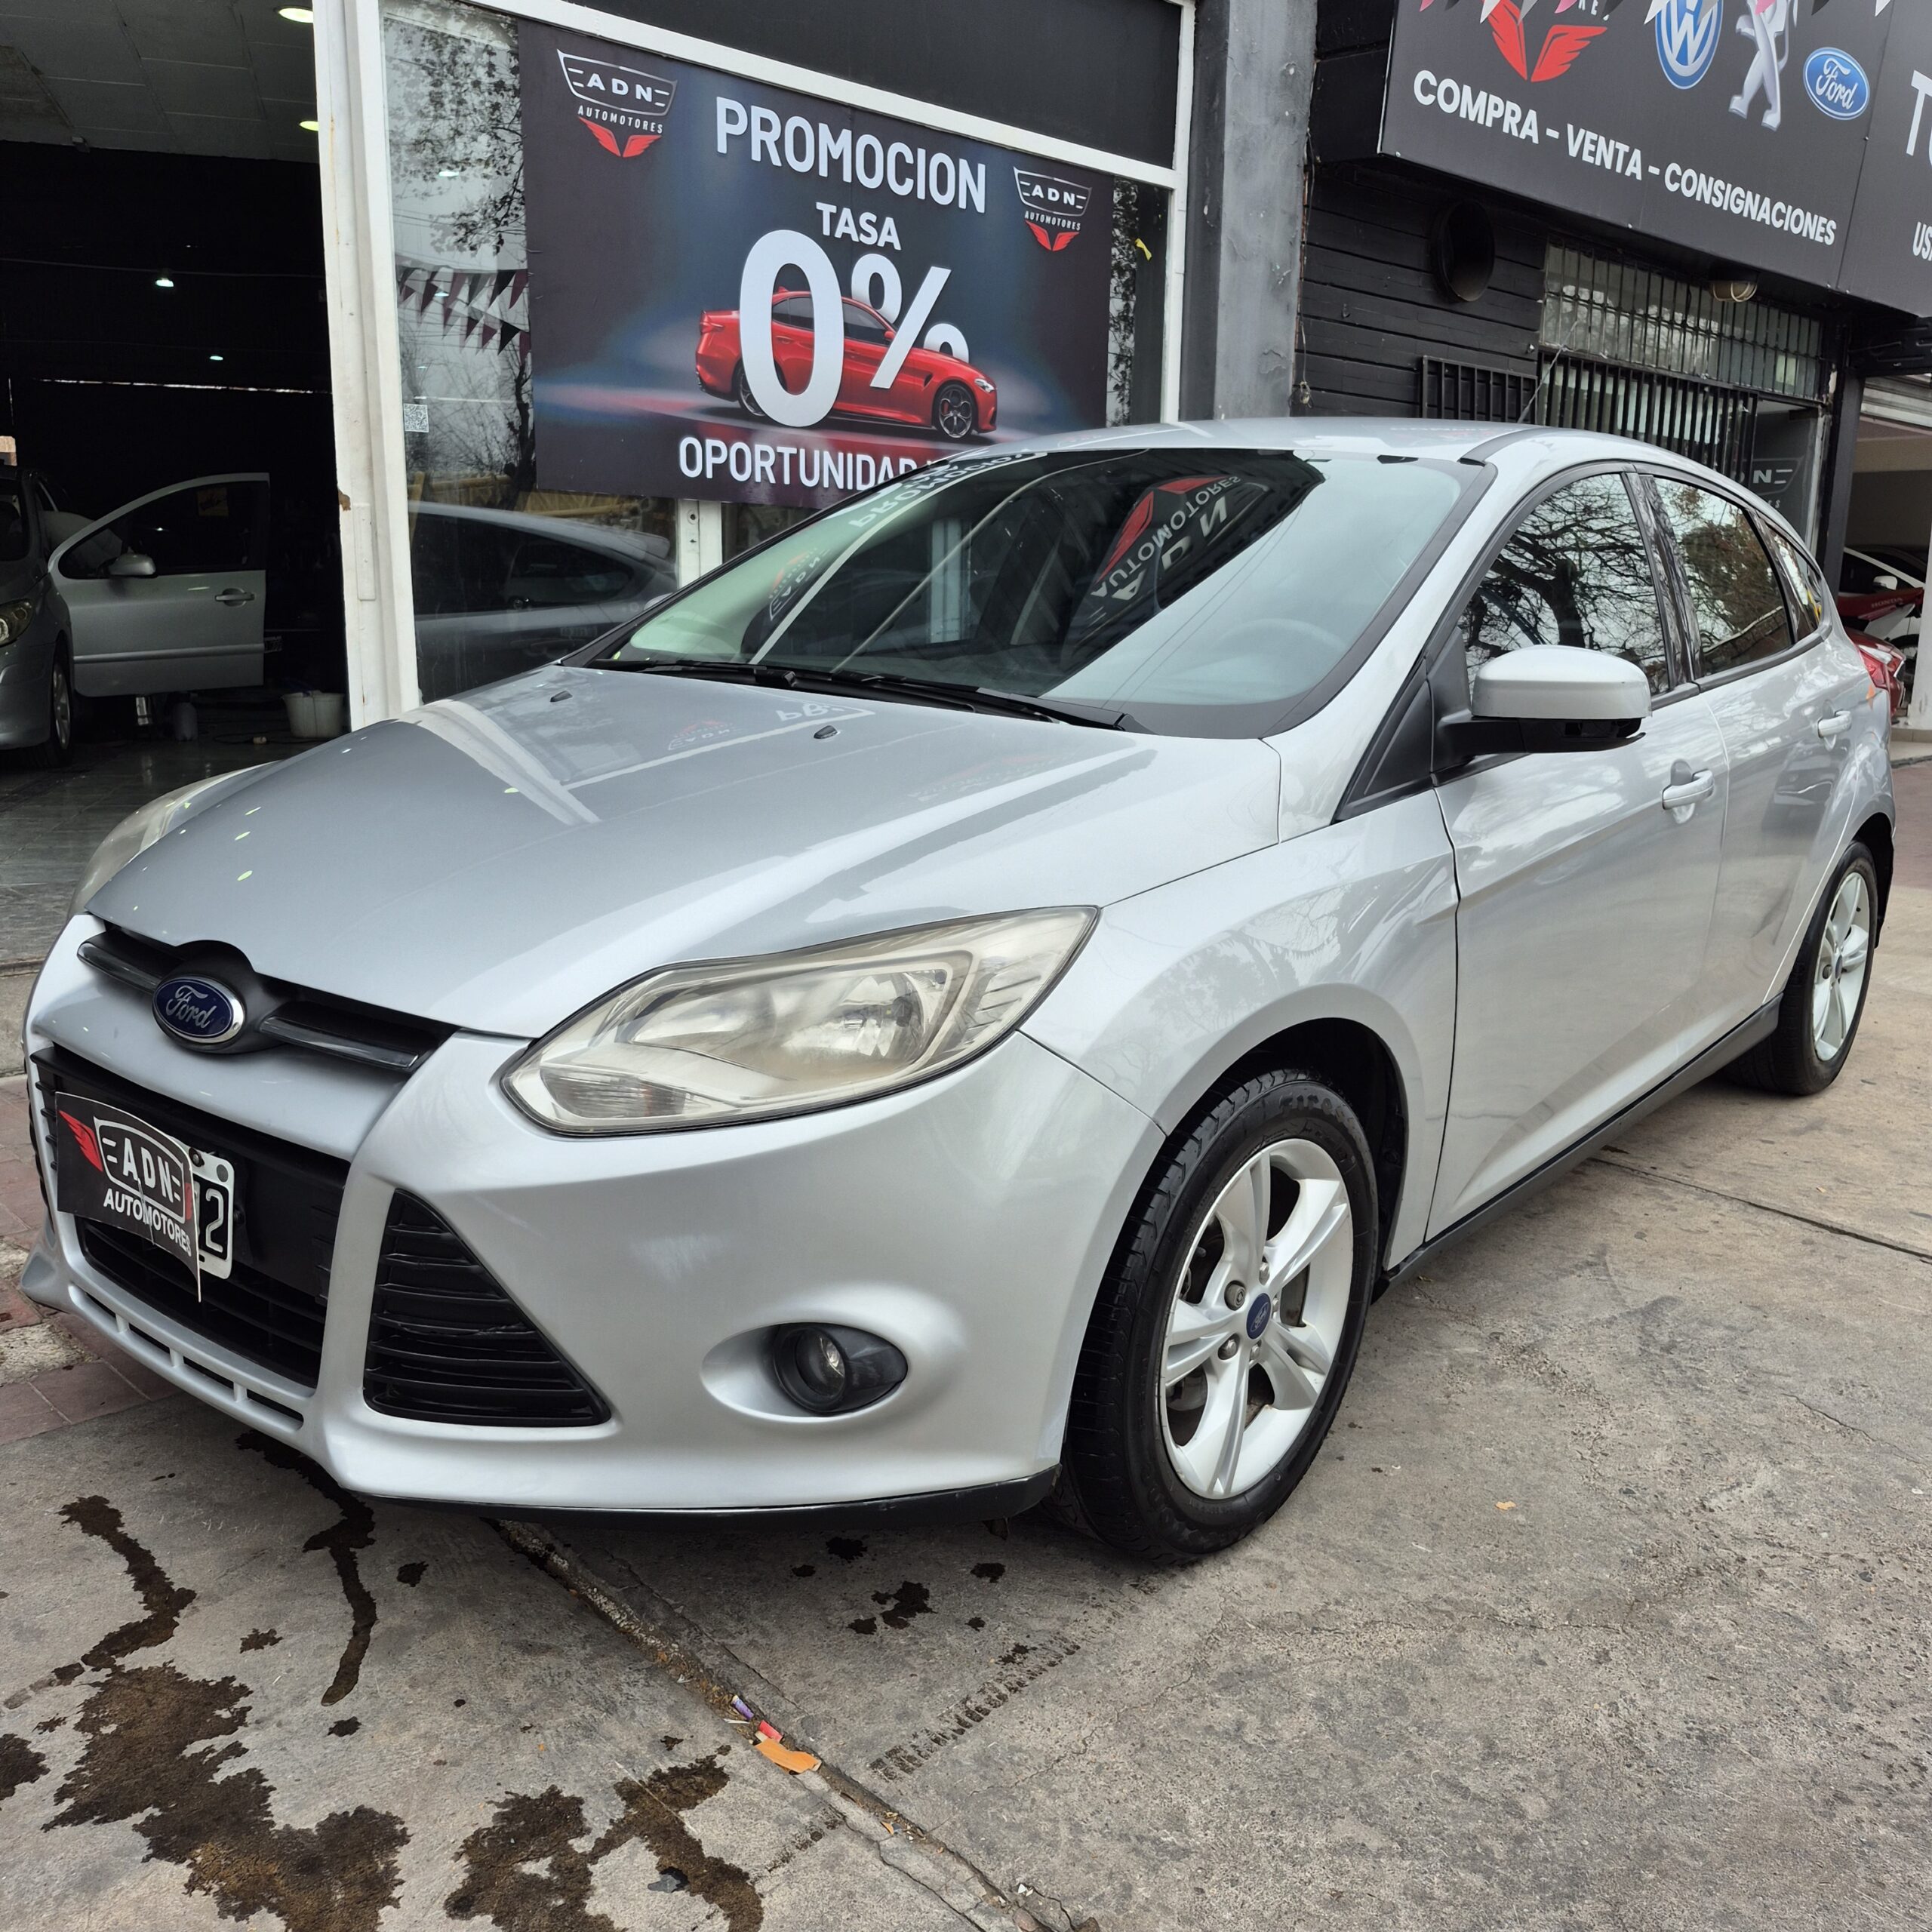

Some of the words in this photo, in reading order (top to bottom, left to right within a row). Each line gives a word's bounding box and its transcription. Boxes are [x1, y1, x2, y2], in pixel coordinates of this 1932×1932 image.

[587, 73, 652, 102] ADN
[1815, 57, 1858, 109] Ford
[577, 105, 663, 134] AUTOMOTORES
[716, 97, 986, 213] PROMOCION
[1414, 69, 1539, 144] COMPRA
[1567, 123, 1643, 180] VENTA
[1664, 162, 1837, 246] CONSIGNACIONES
[1032, 185, 1075, 206] ADN
[816, 202, 900, 251] TASA
[1024, 211, 1081, 231] AUTOMOTORES
[740, 229, 969, 427] 0%
[165, 984, 218, 1029] Ford
[123, 1137, 174, 1203] ADN
[103, 1188, 192, 1257] AUTOMOTORES
